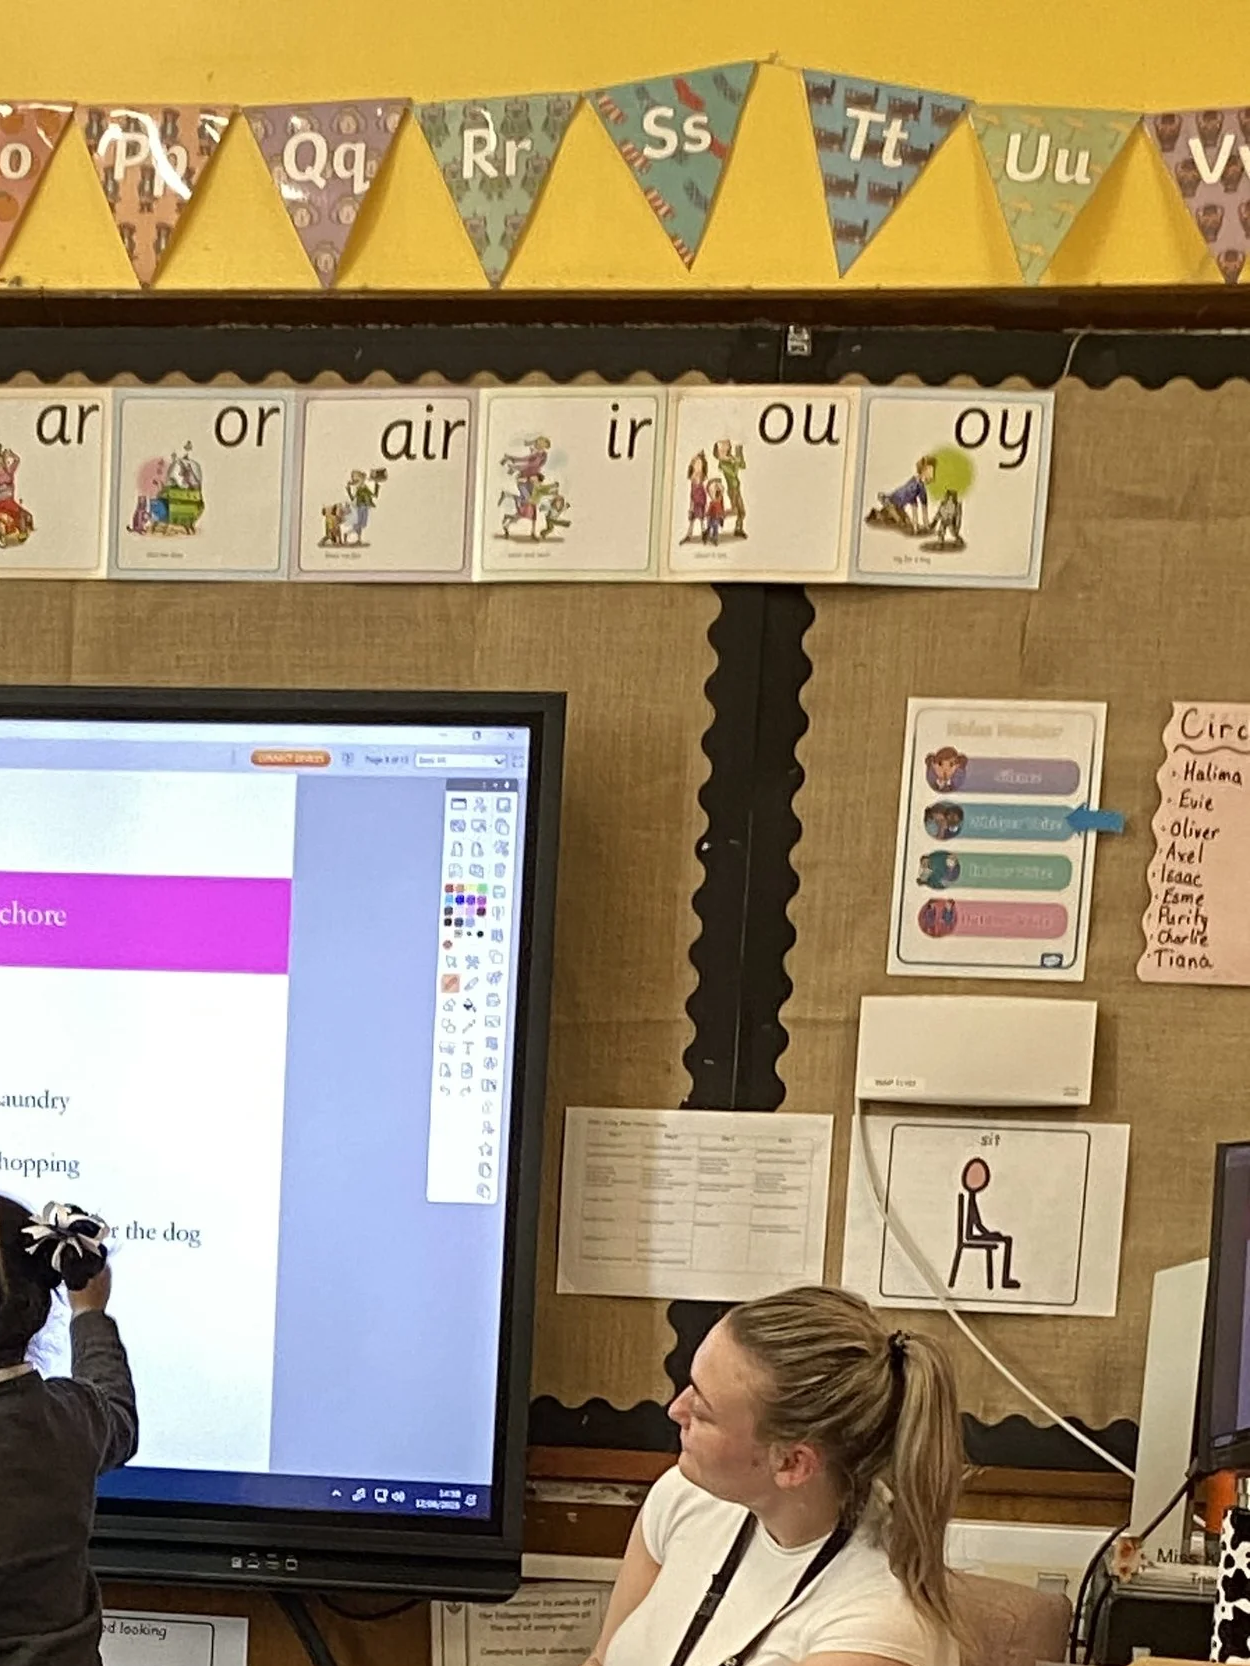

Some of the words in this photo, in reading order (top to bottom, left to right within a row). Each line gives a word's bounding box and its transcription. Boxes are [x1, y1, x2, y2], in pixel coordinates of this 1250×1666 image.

[642, 104, 712, 162] Ss
[845, 106, 910, 168] Tt
[282, 130, 370, 195] Qq
[461, 126, 534, 181] Rr
[1004, 133, 1092, 185] Uu
[35, 402, 99, 445] ar
[214, 404, 280, 449] or
[380, 403, 466, 461] air
[606, 402, 653, 460] ir
[758, 401, 840, 446] ou
[953, 406, 1033, 470] oy
[1183, 760, 1242, 785] Halima
[1179, 788, 1214, 811] Evie
[1170, 819, 1220, 841] Oliver
[1166, 842, 1203, 864] Axel
[1161, 864, 1203, 888] Isaac
[1162, 888, 1204, 908] Esme
[1158, 905, 1209, 934] Purity
[1157, 926, 1209, 947] Charlie
[1154, 948, 1213, 969] Tiana
[980, 1132, 1001, 1147] sit
[126, 1220, 157, 1241] the
[163, 1221, 202, 1248] dog
[120, 1621, 167, 1641] looking
